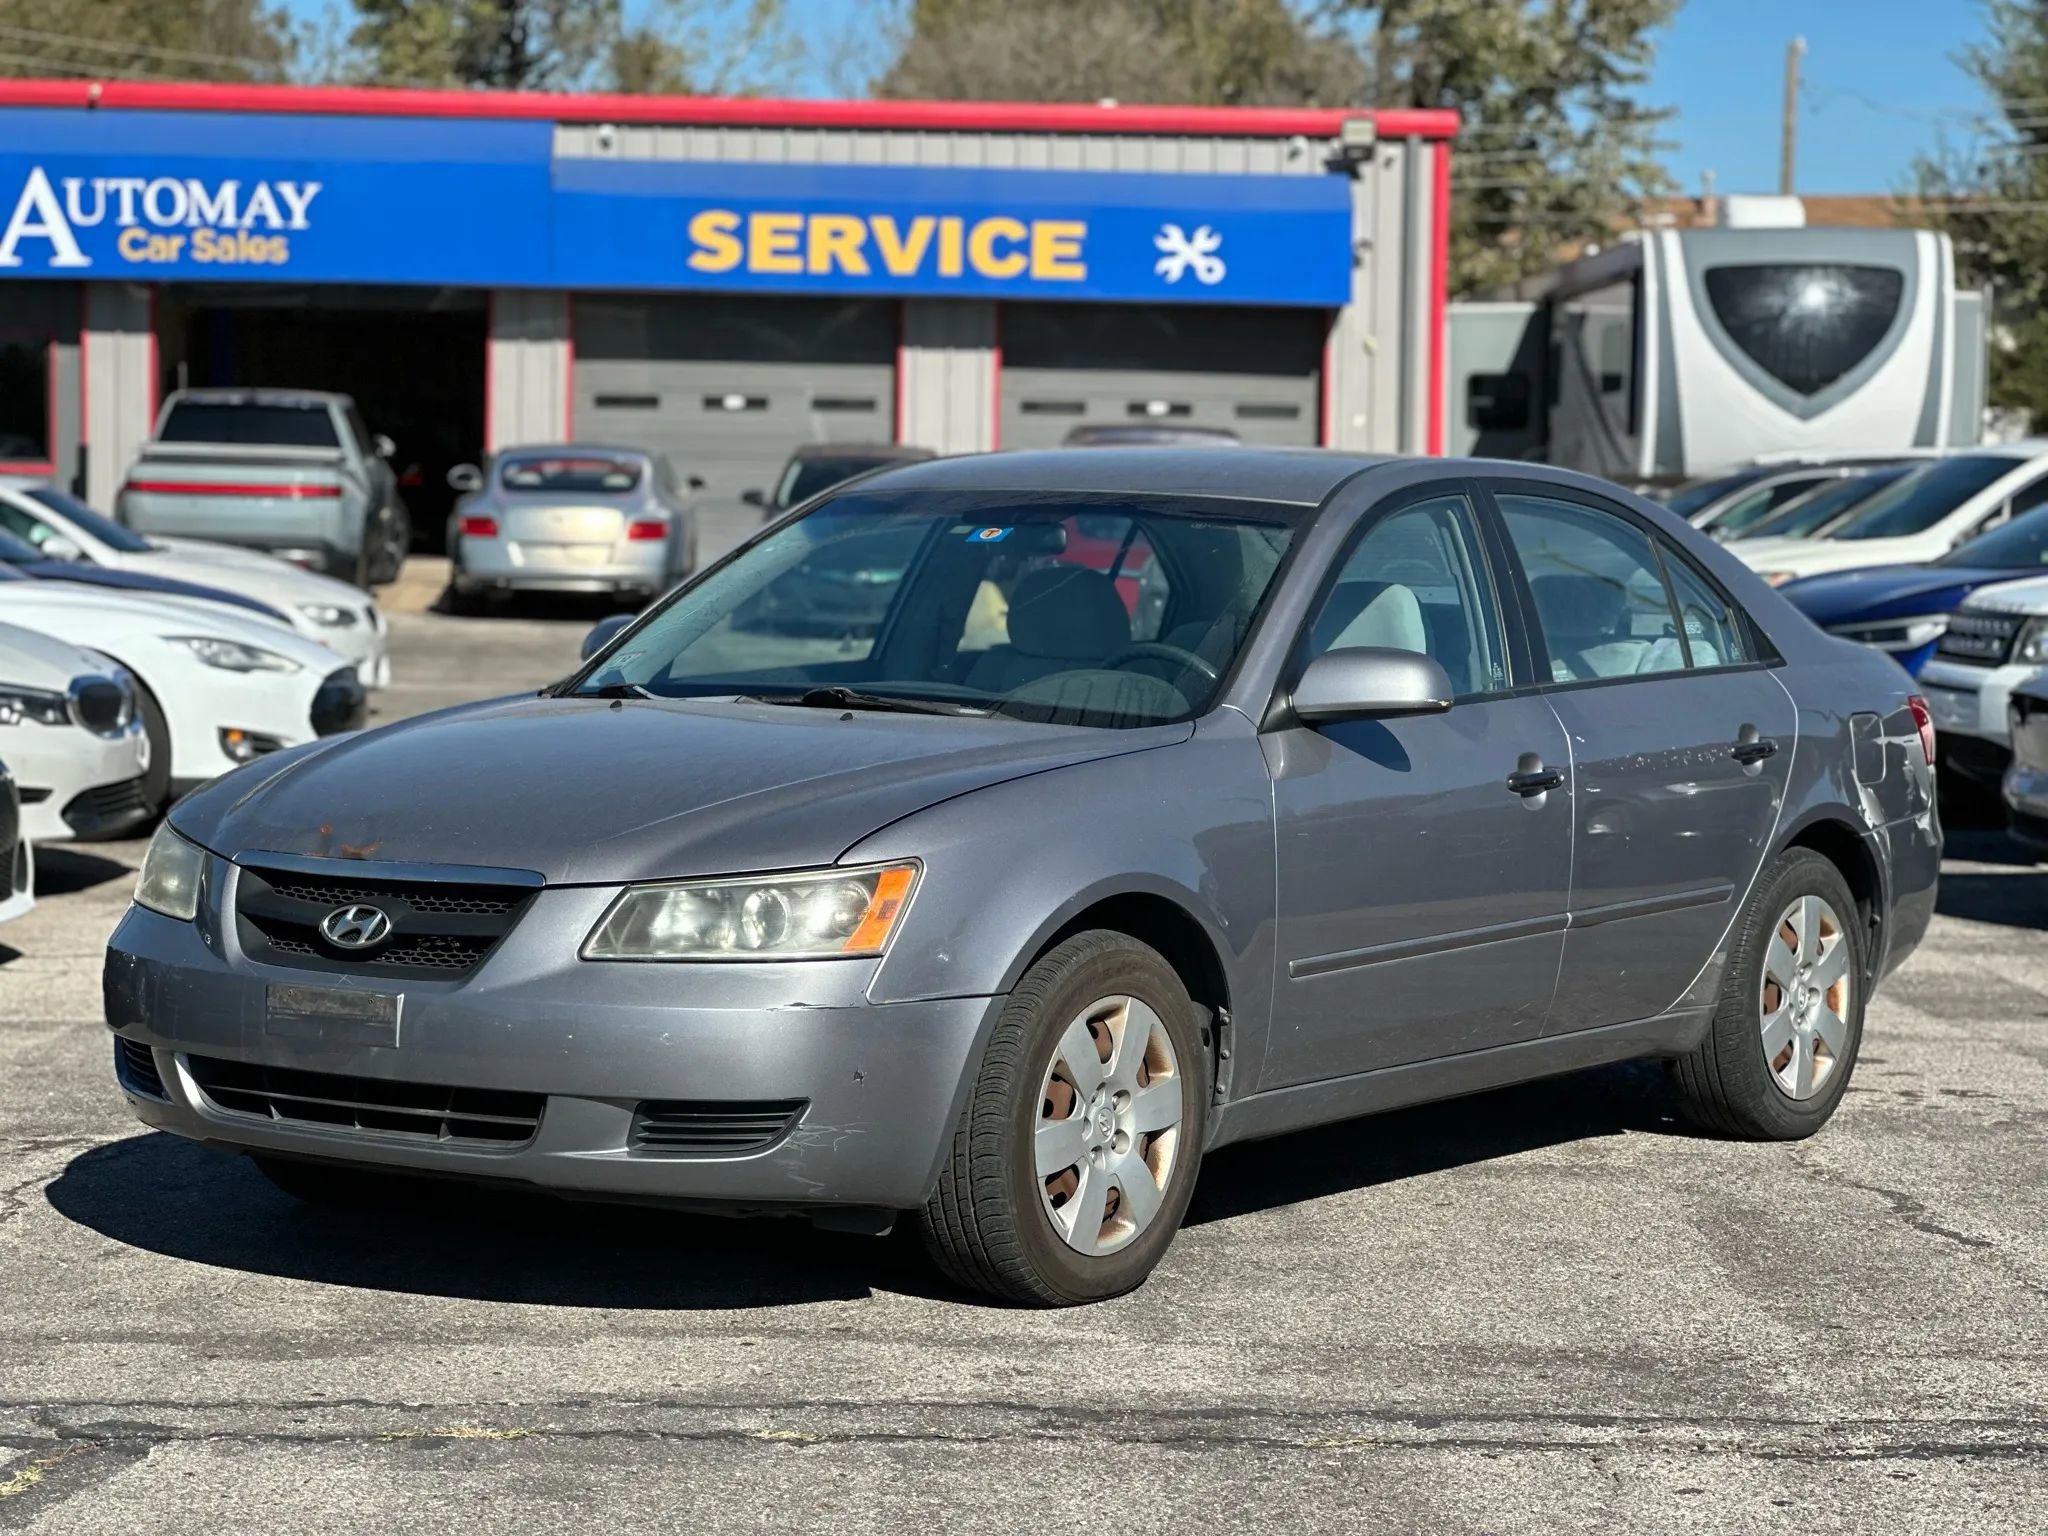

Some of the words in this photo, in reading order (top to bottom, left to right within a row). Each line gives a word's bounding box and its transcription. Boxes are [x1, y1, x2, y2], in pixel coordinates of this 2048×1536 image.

[117, 226, 186, 263] Car
[190, 227, 289, 265] Sales
[687, 210, 1087, 281] SERVICE
